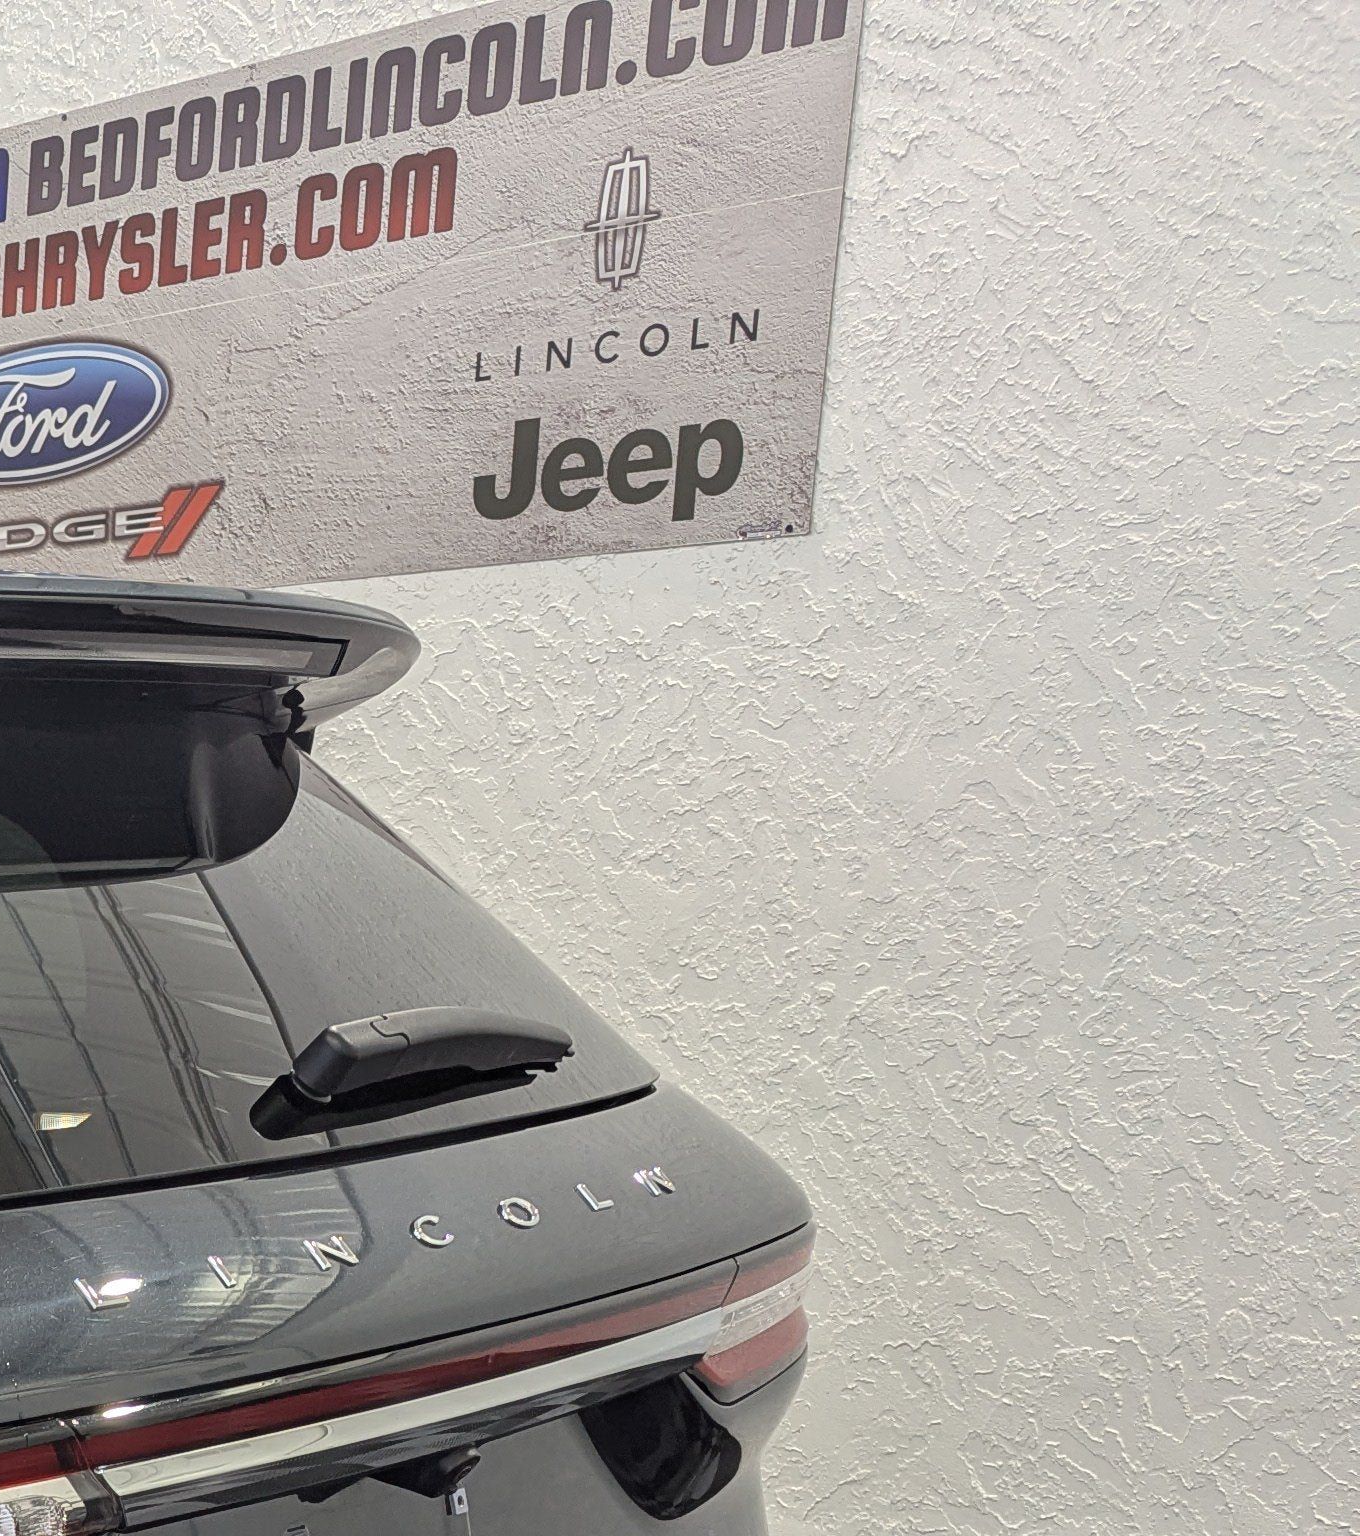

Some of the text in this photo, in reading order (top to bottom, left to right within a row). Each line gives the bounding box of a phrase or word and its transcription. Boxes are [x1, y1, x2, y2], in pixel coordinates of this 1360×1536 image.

[474, 308, 761, 383] LINCOLN
[473, 417, 745, 522] Jeep
[74, 1165, 678, 1309] LINCOLN
